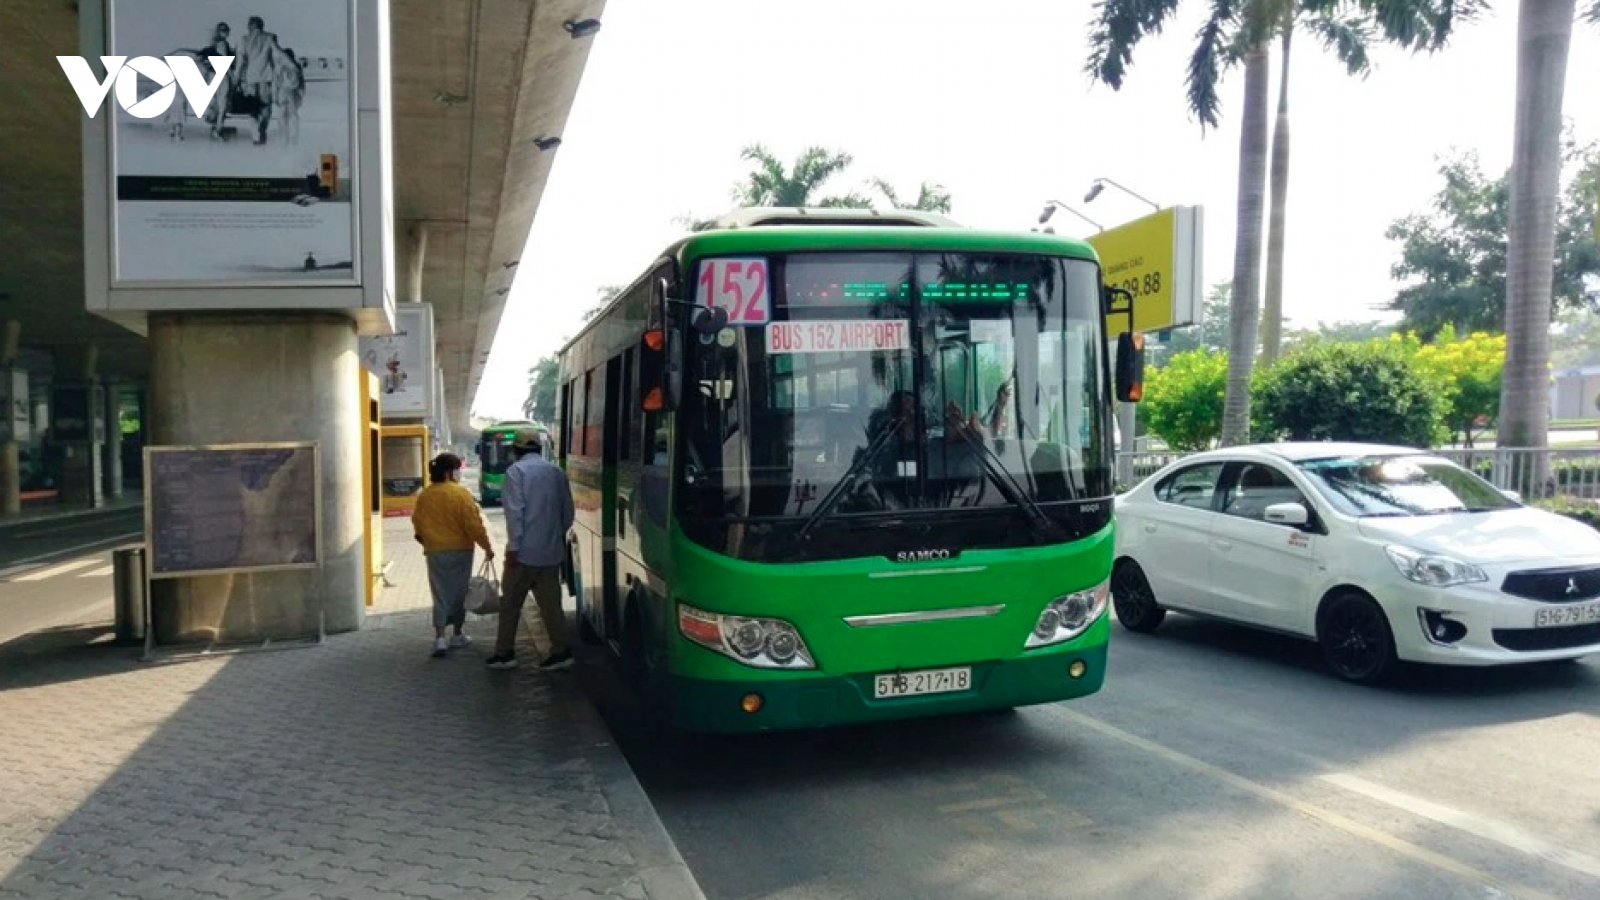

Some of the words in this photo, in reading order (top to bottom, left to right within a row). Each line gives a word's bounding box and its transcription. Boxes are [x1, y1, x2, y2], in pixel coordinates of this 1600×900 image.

[701, 262, 765, 321] 152
[772, 325, 802, 350] BUS
[809, 324, 835, 349] 152
[840, 322, 904, 349] AIRPORT
[896, 549, 950, 562] SAMCO
